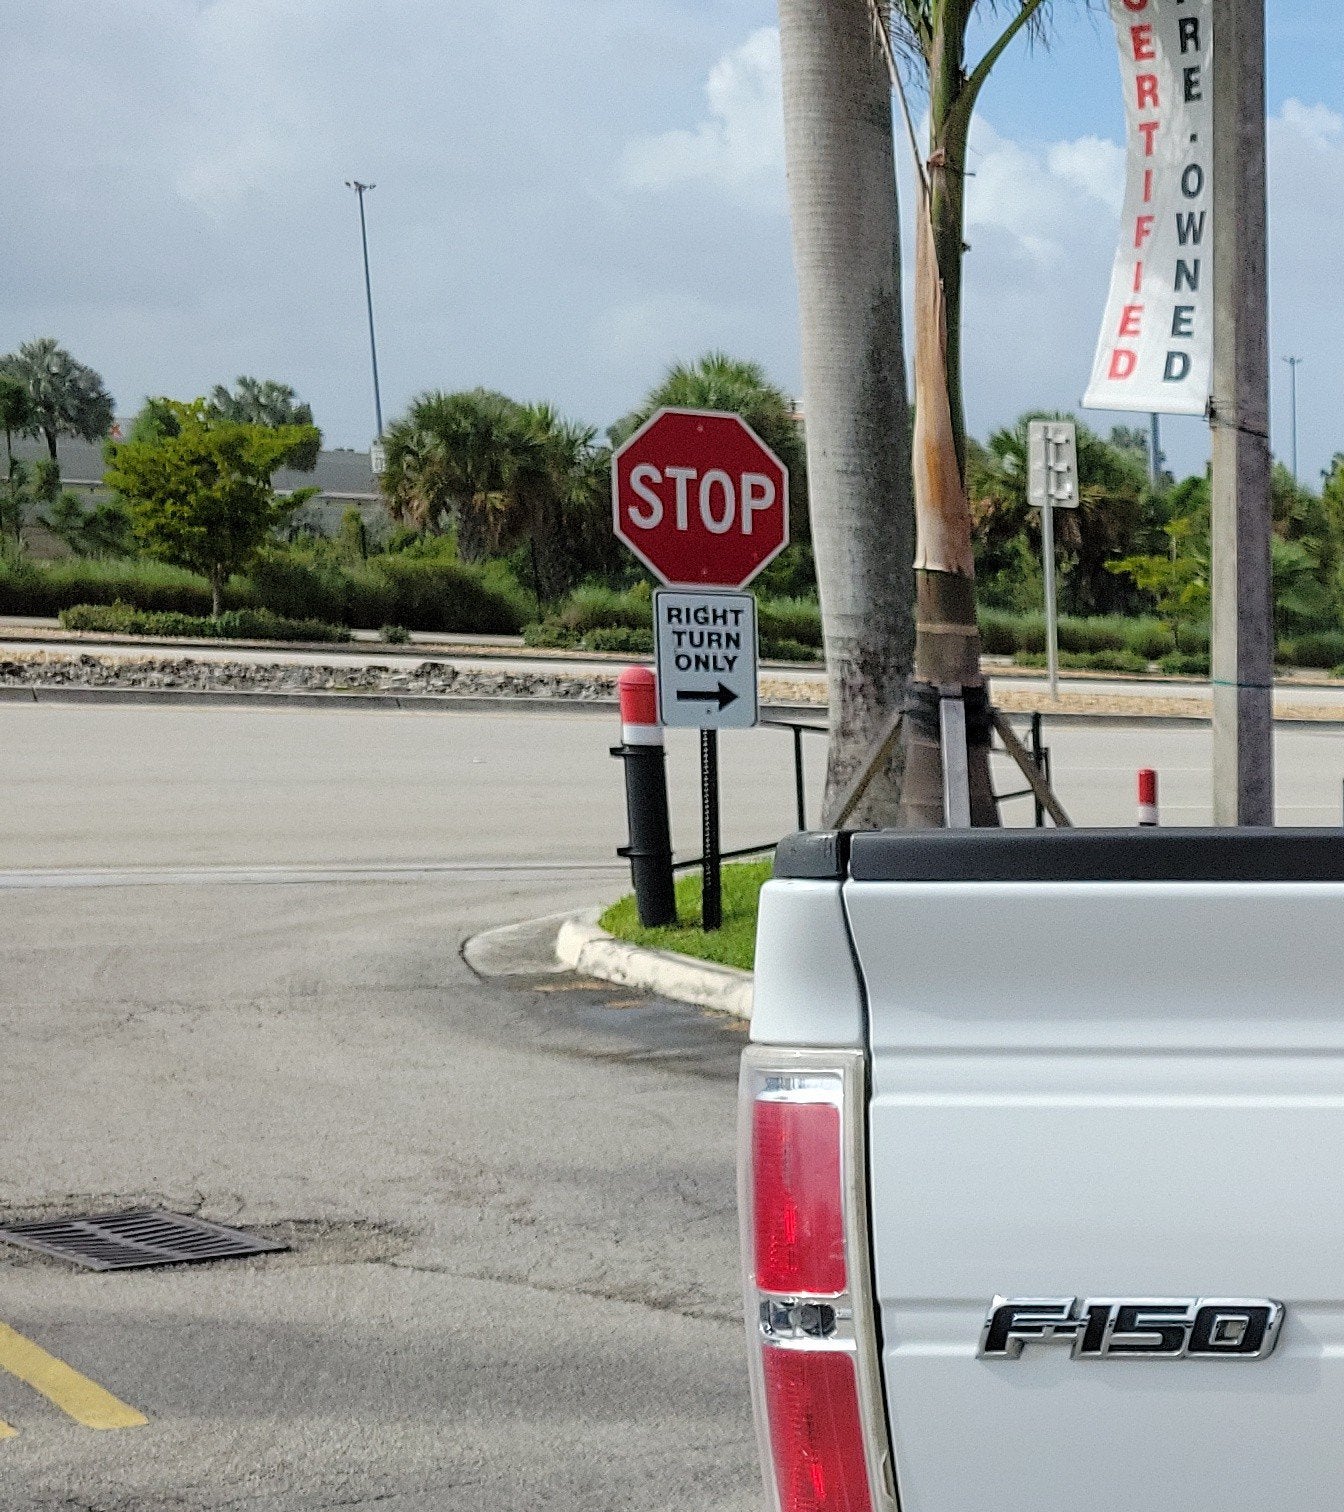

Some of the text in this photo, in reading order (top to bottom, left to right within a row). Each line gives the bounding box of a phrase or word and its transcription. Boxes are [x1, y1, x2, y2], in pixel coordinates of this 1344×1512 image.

[628, 463, 776, 535] STOP
[667, 606, 746, 627] RIGHT
[672, 631, 741, 649] TURN
[675, 654, 739, 672] ONLY
[976, 1295, 1286, 1360] F-150
